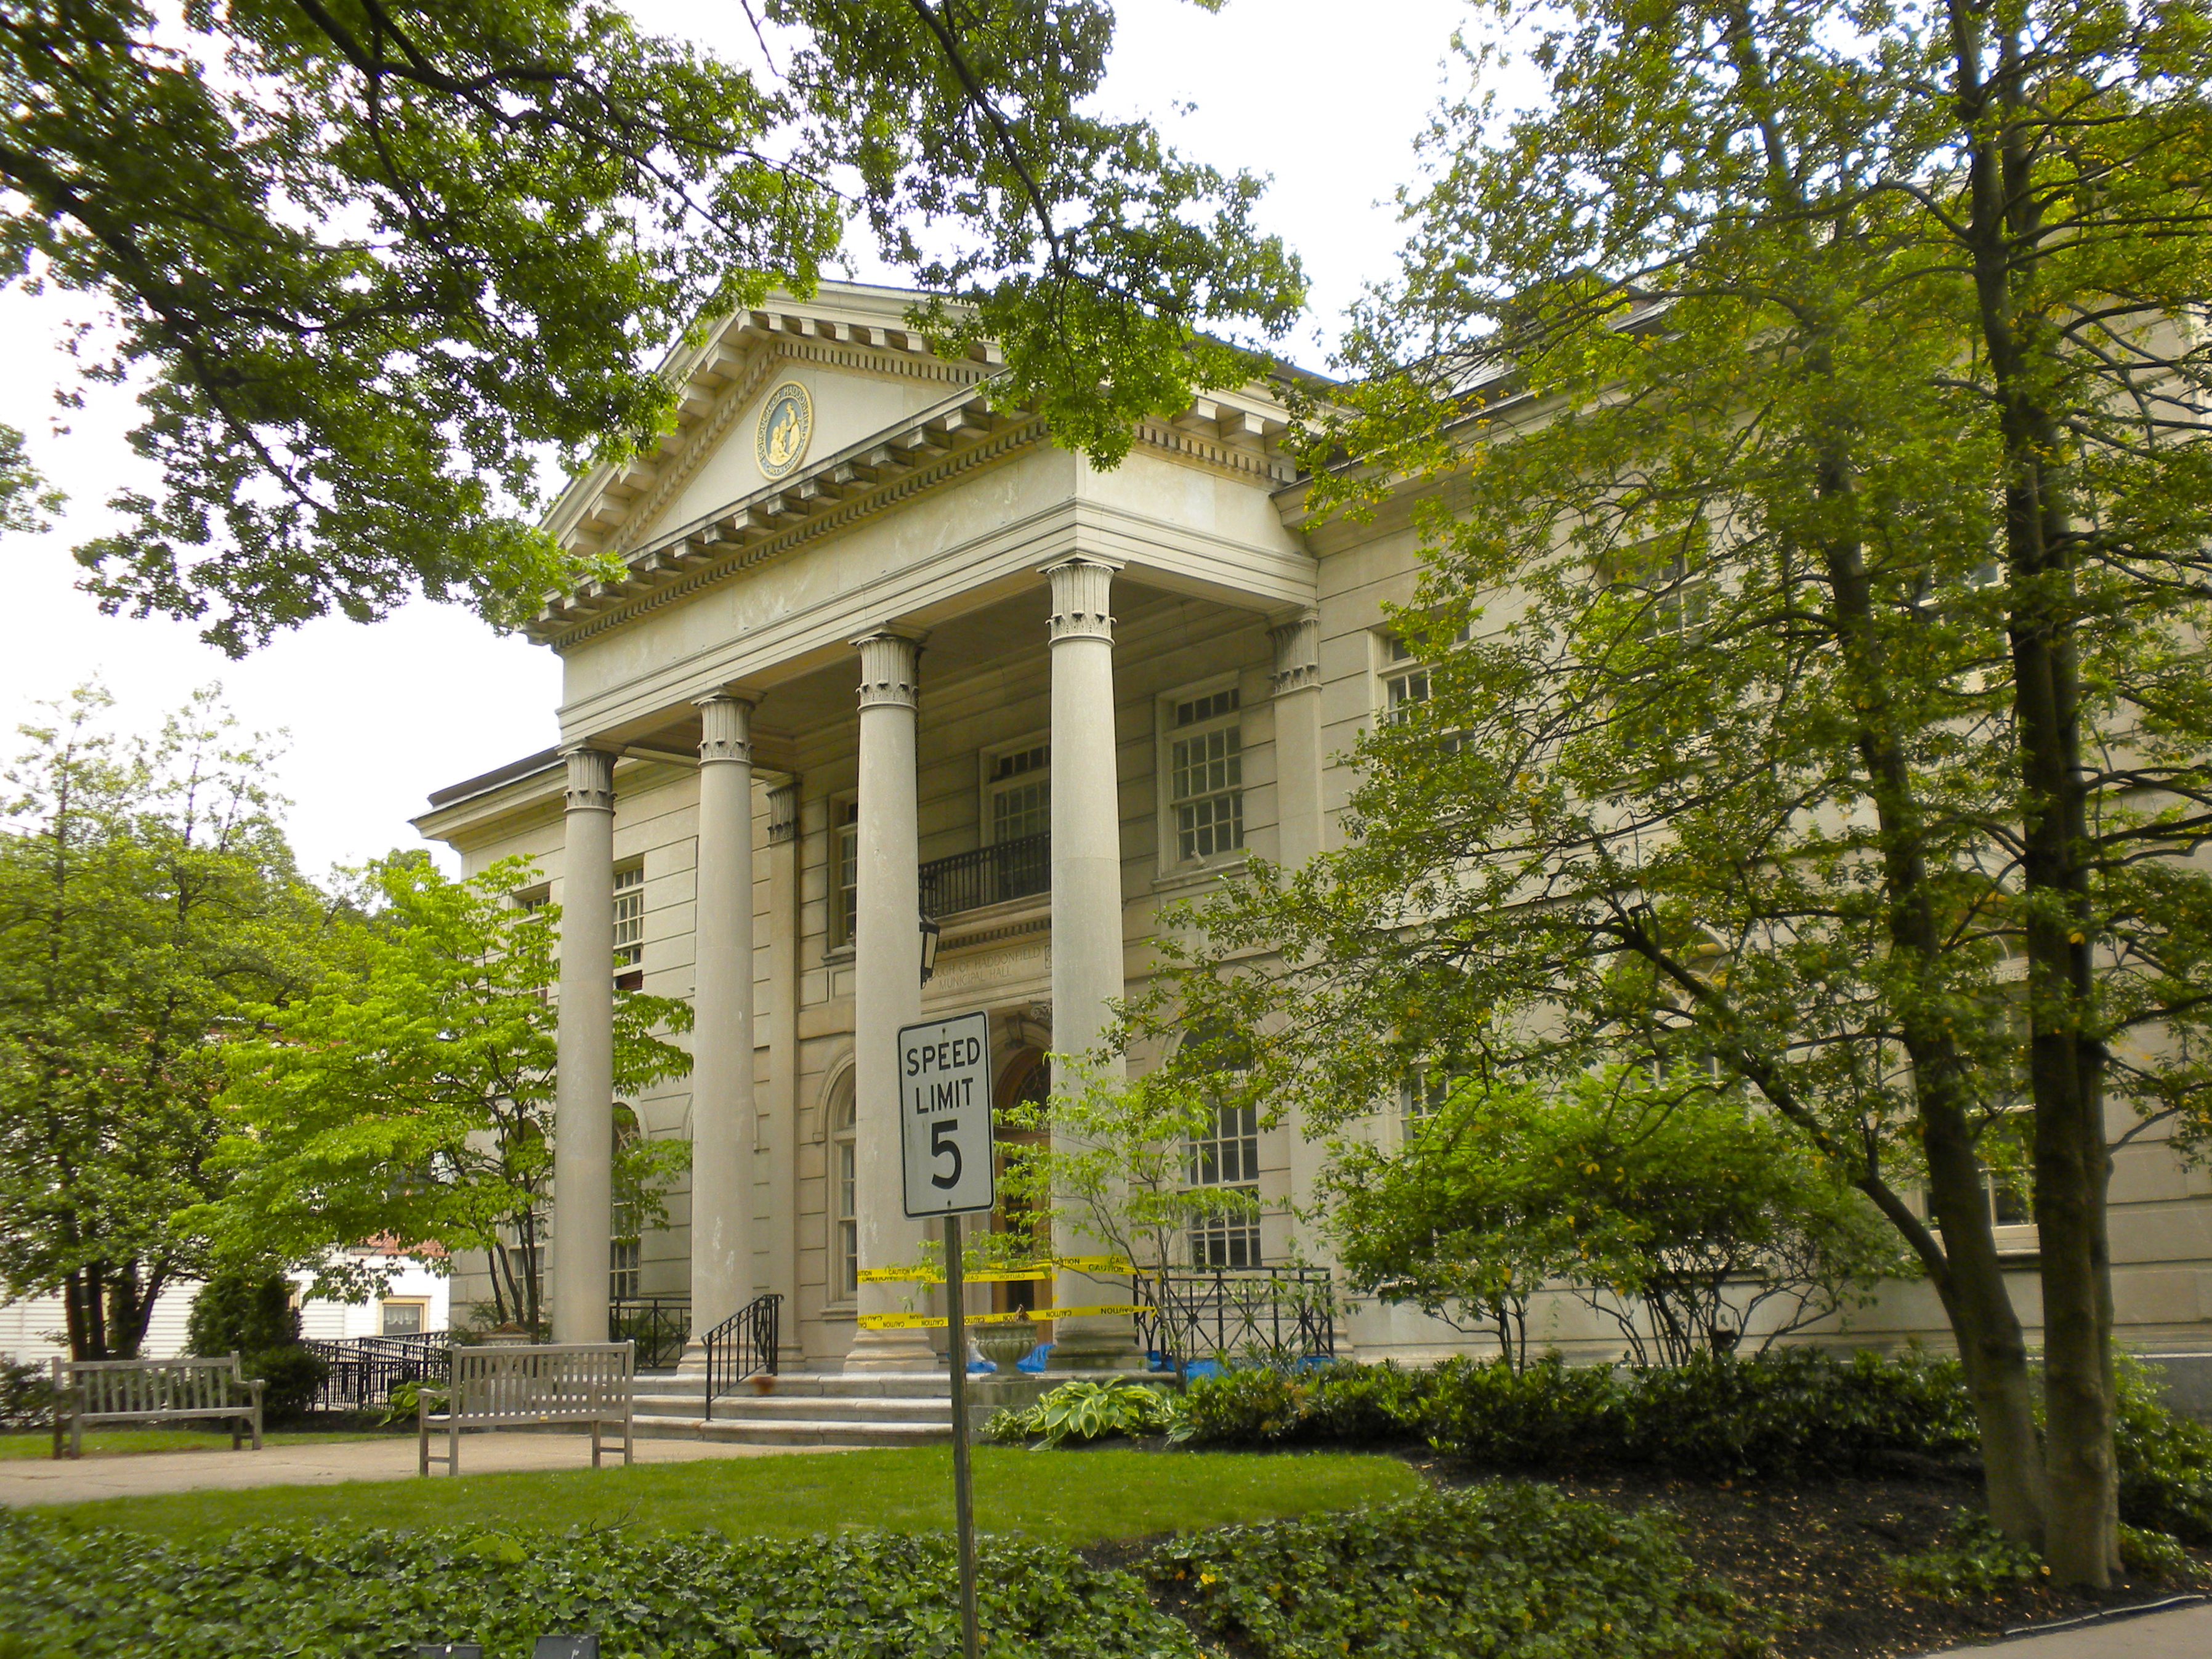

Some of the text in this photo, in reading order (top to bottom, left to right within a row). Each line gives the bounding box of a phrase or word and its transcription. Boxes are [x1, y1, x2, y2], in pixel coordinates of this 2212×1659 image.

[757, 385, 810, 461] BOROUGH OF HADDONFIELD
[932, 947, 1041, 979] OUGH OF HADDONFIELD
[939, 966, 1012, 990] MUNICIPAL HALL
[906, 1036, 980, 1077] SPEED
[916, 1077, 974, 1115] LIMIT
[930, 1118, 962, 1190] 5
[888, 1267, 910, 1275] CAUTION
[1088, 1263, 1124, 1273] CAUTION
[1110, 1256, 1130, 1264] CAUT
[1046, 1309, 1072, 1318] CAUTION
